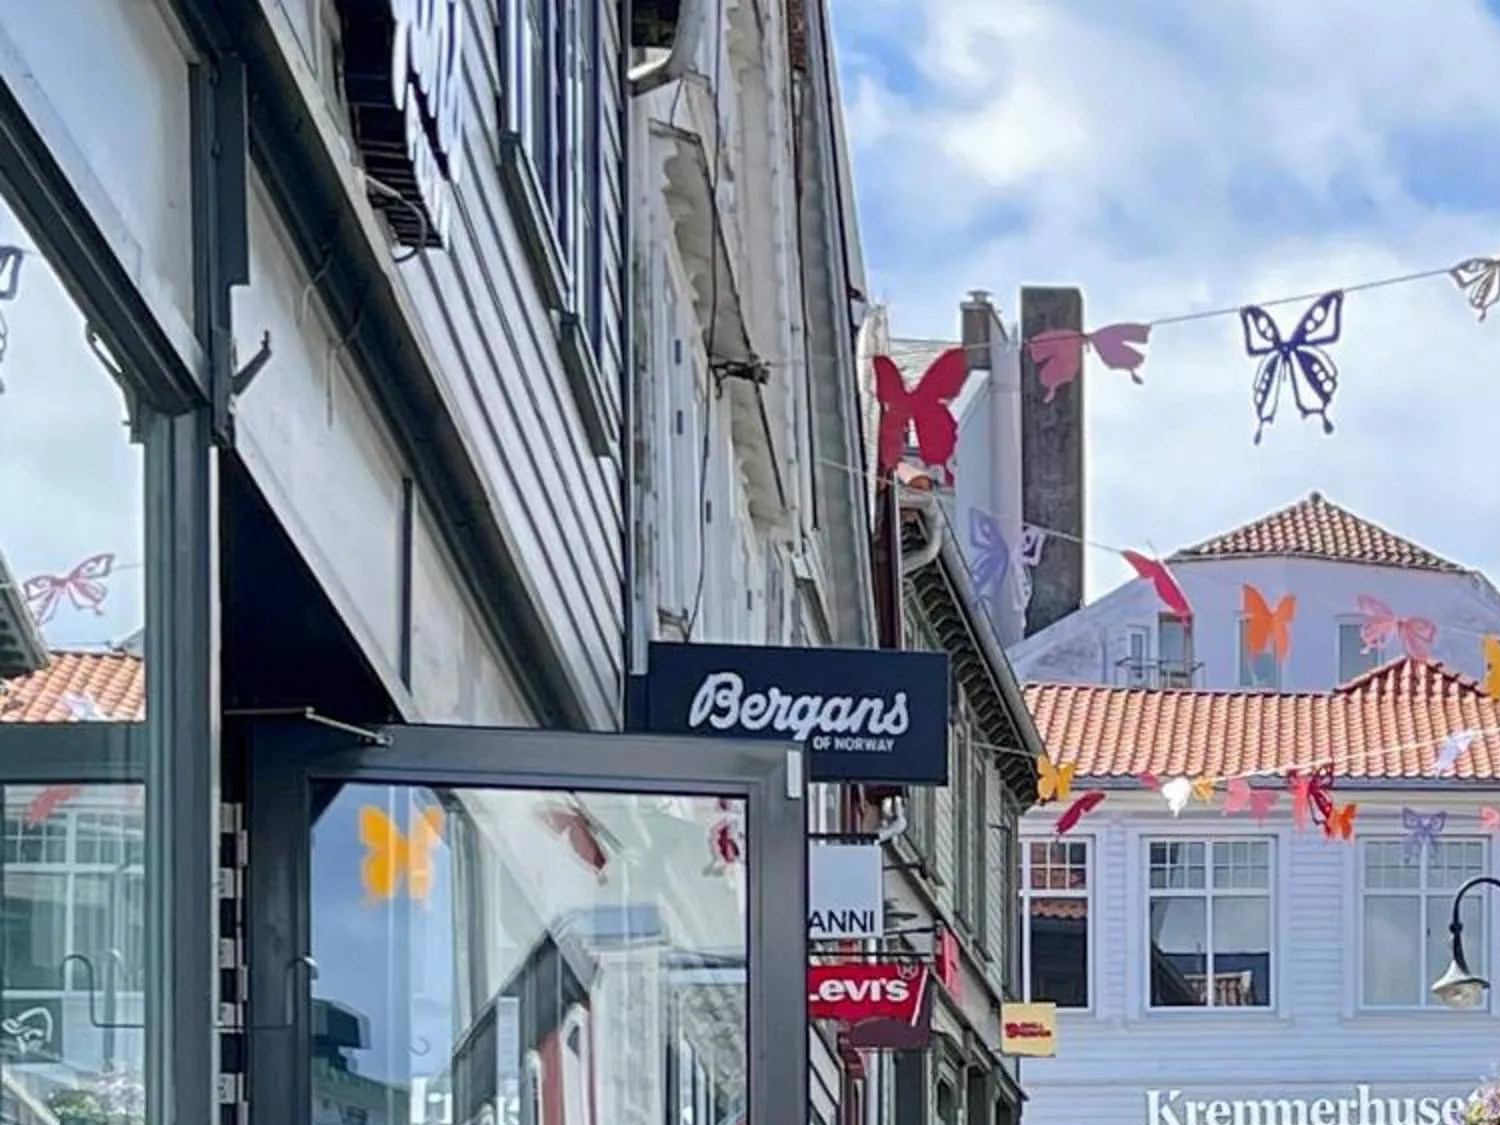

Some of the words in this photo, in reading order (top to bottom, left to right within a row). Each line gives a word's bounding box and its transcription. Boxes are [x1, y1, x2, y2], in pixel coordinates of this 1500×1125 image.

[689, 672, 909, 741] Bergans
[813, 735, 832, 751] OF
[834, 736, 895, 753] NORWAY
[808, 910, 875, 933] ANNI
[809, 977, 910, 1003] evi's
